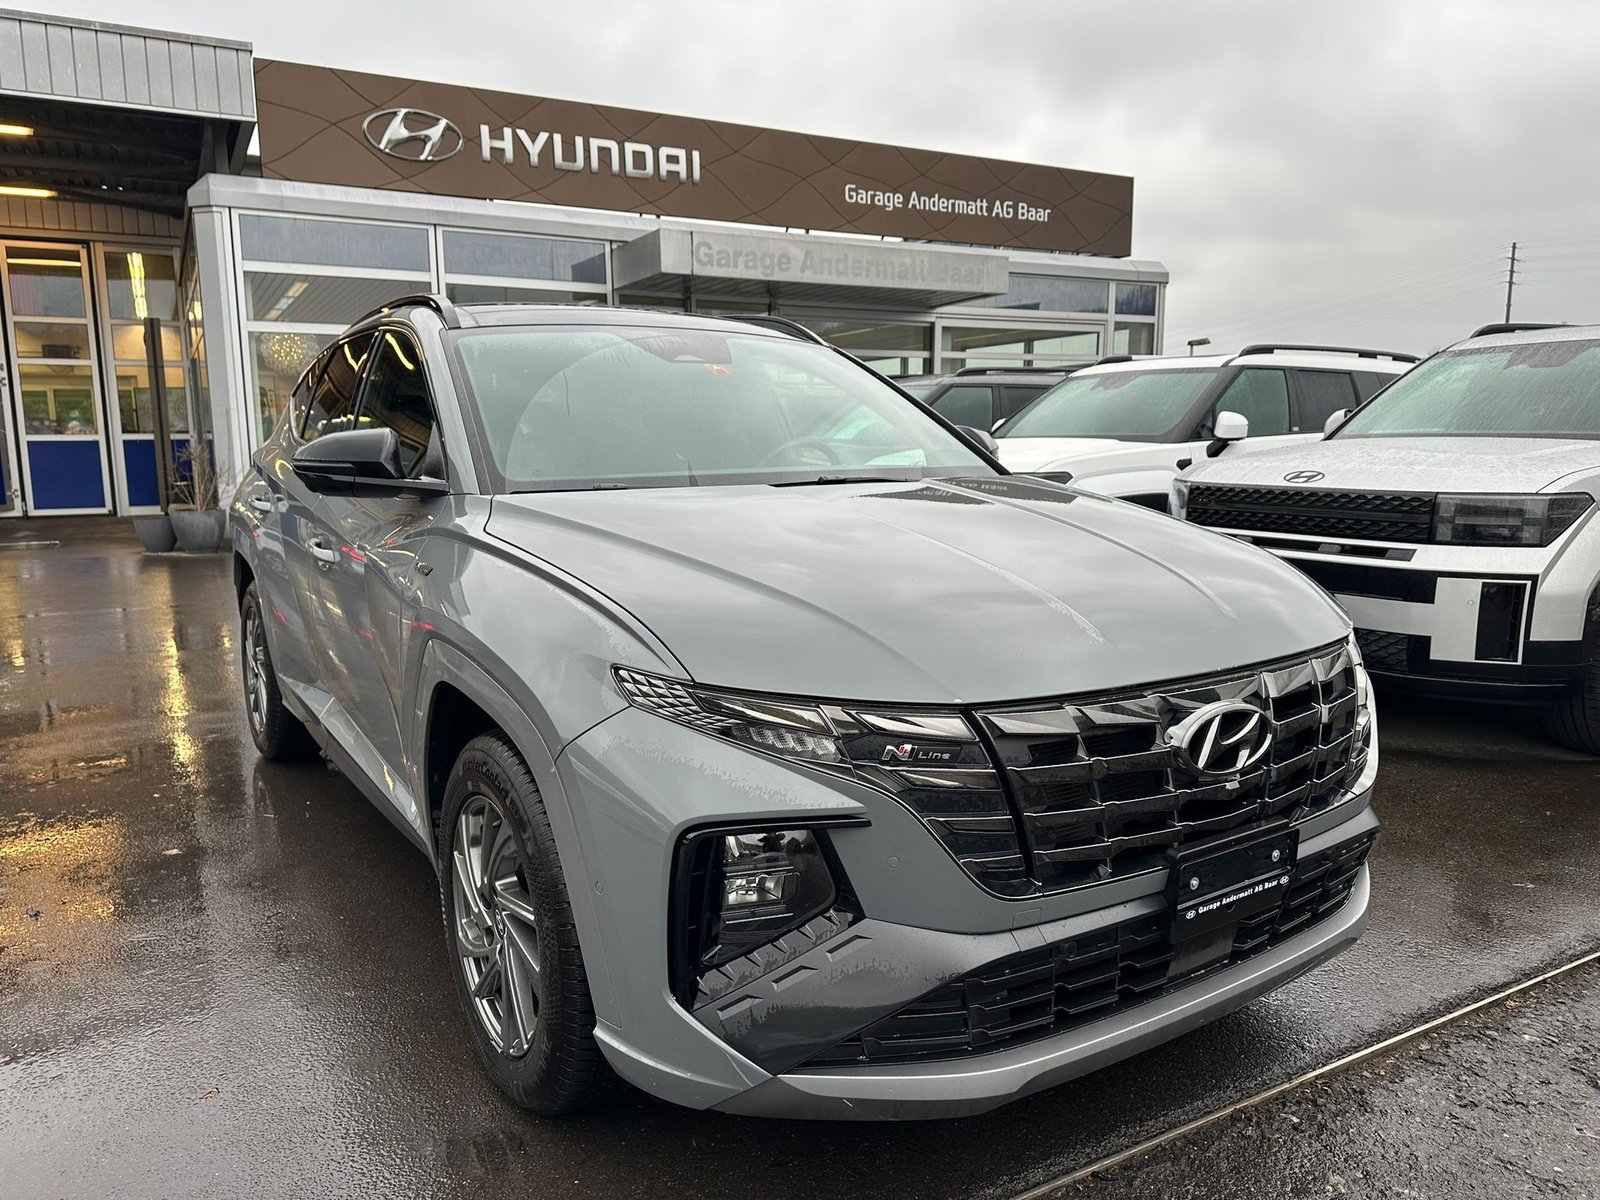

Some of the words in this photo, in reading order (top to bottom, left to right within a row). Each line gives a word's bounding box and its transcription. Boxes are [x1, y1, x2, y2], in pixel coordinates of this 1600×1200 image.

[479, 124, 700, 185] HYUNDAI
[844, 184, 903, 211] Garage
[908, 191, 988, 216] Andermatt
[992, 200, 1014, 218] AG
[1018, 202, 1051, 222] Baar
[695, 241, 791, 277] Garage
[800, 250, 927, 282] Andermatt
[936, 262, 985, 286] Baar
[1198, 901, 1221, 914] Garage
[1221, 886, 1254, 905] Andermatt
[1254, 884, 1264, 893] AG
[1264, 879, 1278, 889] Baar
